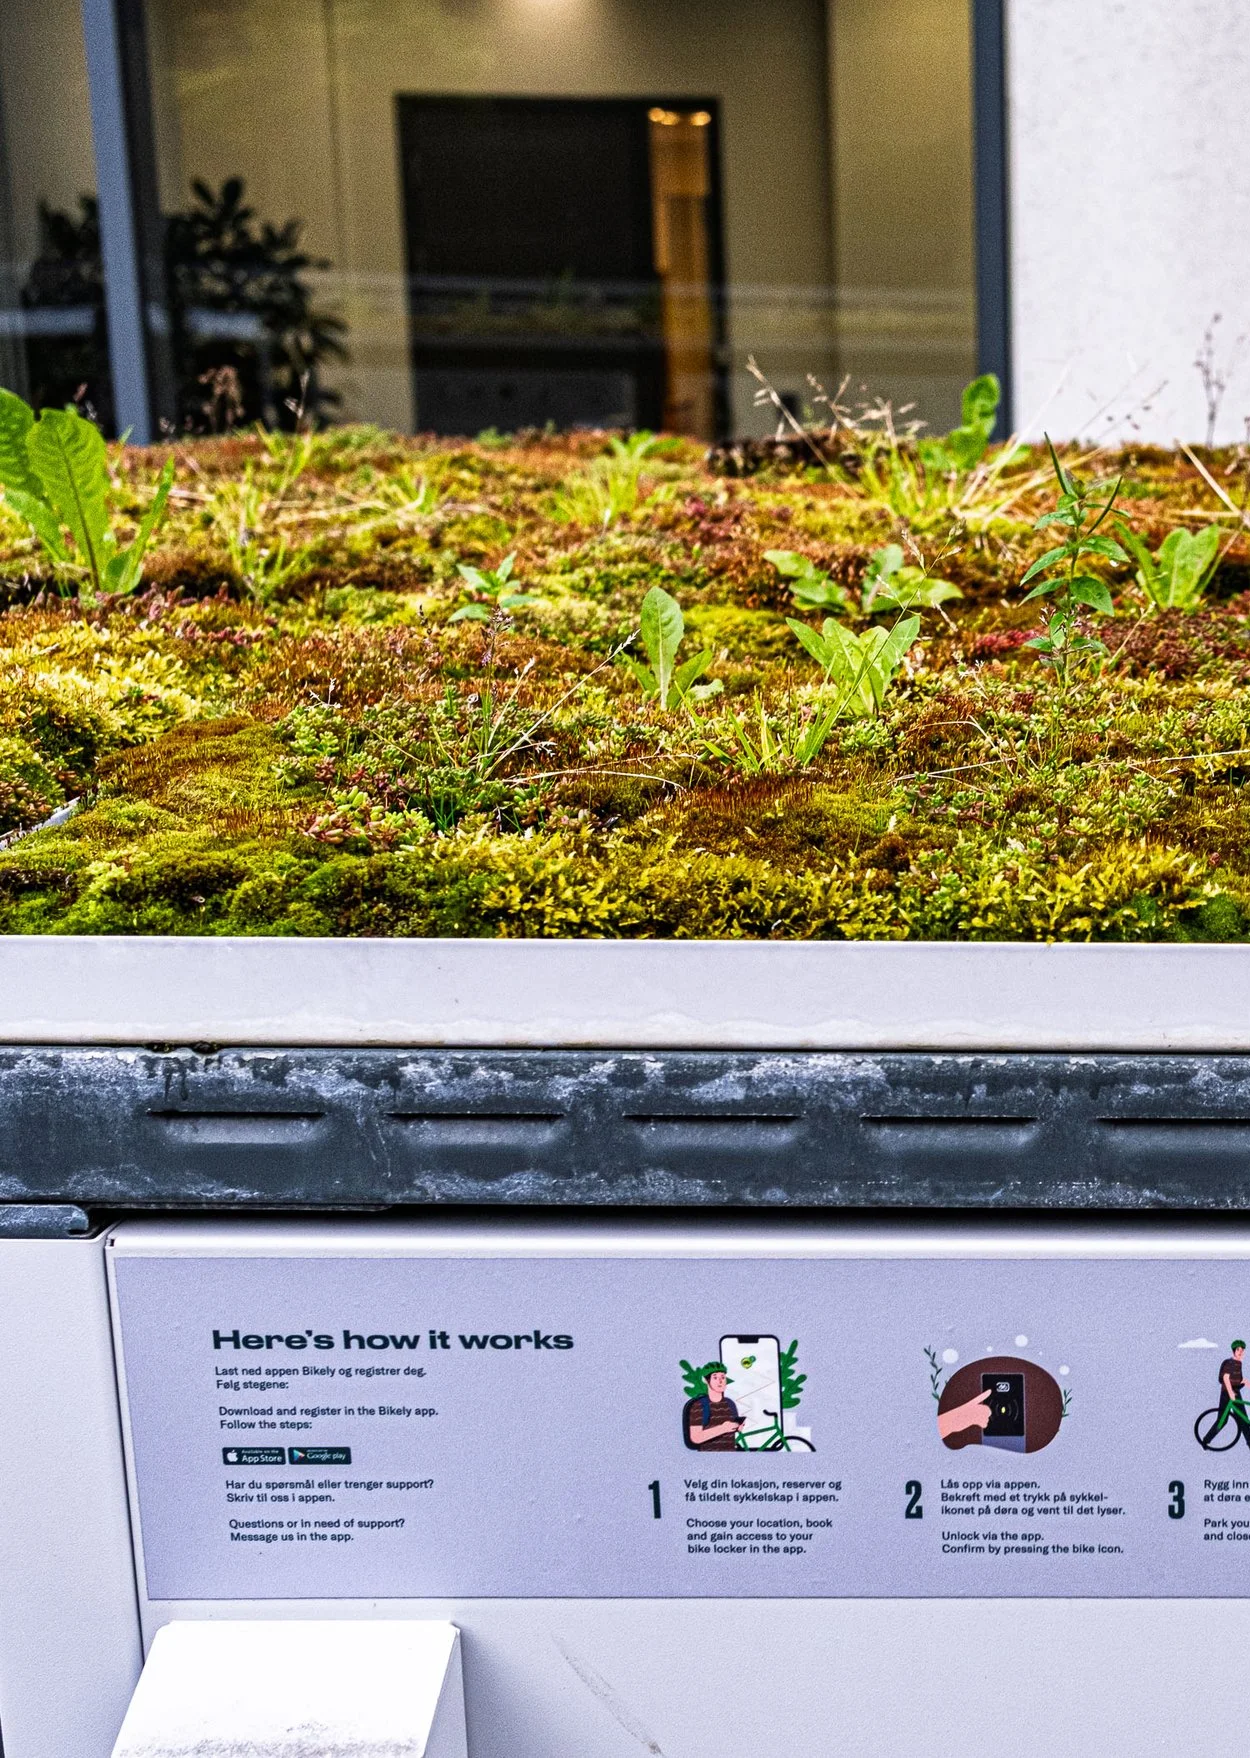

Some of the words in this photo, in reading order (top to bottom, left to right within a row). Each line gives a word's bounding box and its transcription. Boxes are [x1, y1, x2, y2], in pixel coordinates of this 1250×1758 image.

[212, 1330, 335, 1350] Here's
[343, 1330, 420, 1350] how
[429, 1330, 451, 1349] it
[458, 1330, 574, 1350] works
[215, 1366, 239, 1376] Last
[241, 1366, 262, 1376] ned
[265, 1368, 299, 1377] appen
[302, 1366, 336, 1378] Bikely
[338, 1367, 353, 1378] og
[355, 1366, 401, 1378] registrer
[403, 1366, 427, 1378] deg.
[216, 1379, 241, 1391] Følg
[242, 1380, 289, 1391] stegene:
[219, 1406, 273, 1416] Download
[276, 1406, 297, 1416] and
[300, 1406, 342, 1418] register
[344, 1406, 355, 1415] in
[357, 1406, 376, 1416] the
[378, 1406, 412, 1418] Bikely
[415, 1408, 439, 1417] app.
[220, 1419, 256, 1429] Follow
[258, 1420, 277, 1429] the
[279, 1420, 312, 1431] steps:
[241, 1454, 260, 1464] App
[260, 1454, 282, 1462] Store
[306, 1452, 331, 1461] Google
[225, 1480, 245, 1489] Har
[248, 1480, 262, 1489] du
[265, 1479, 315, 1491] spørsmål
[317, 1479, 342, 1489] eller
[344, 1480, 383, 1491] trenger
[386, 1479, 434, 1491] support?
[684, 1479, 708, 1491] Velg
[710, 1479, 728, 1489] din
[731, 1479, 779, 1491] lokasjon,
[782, 1481, 826, 1489] reserver
[828, 1481, 842, 1491] og
[941, 1479, 959, 1489] Lås
[962, 1481, 983, 1491] opp
[985, 1480, 1001, 1489] via
[1004, 1481, 1040, 1491] appen.
[1204, 1479, 1230, 1491] Rygg
[1232, 1480, 1249, 1489] inn
[226, 1493, 254, 1503] Skriv
[256, 1493, 267, 1502] til
[298, 1495, 335, 1504] appen.
[648, 1480, 661, 1519] 1
[685, 1492, 696, 1502] få
[698, 1492, 730, 1502] tildelt
[733, 1492, 793, 1504] sykkelskap
[802, 1494, 839, 1503] appen.
[905, 1480, 923, 1519] 2
[941, 1492, 980, 1502] Bekreft
[983, 1492, 1006, 1502] med
[1009, 1493, 1020, 1502] et
[1023, 1492, 1050, 1504] trykk
[1053, 1492, 1067, 1503] på
[1070, 1492, 1108, 1504] sykkel-
[1168, 1480, 1185, 1520] 3
[1204, 1493, 1214, 1502] at
[1217, 1492, 1241, 1502] døra
[941, 1505, 975, 1515] ikonet
[978, 1505, 991, 1517] på
[994, 1505, 1018, 1515] døra
[1021, 1507, 1034, 1517] og
[1037, 1506, 1060, 1515] vent
[1063, 1505, 1073, 1515] til
[1076, 1505, 1094, 1515] det
[1097, 1505, 1125, 1517] lyser.
[229, 1519, 284, 1530] Questions
[301, 1519, 311, 1528] in
[314, 1519, 341, 1528] need
[343, 1518, 354, 1528] of
[357, 1518, 405, 1530] support?
[686, 1518, 727, 1528] Choose
[729, 1520, 754, 1530] your
[756, 1518, 803, 1529] location,
[806, 1518, 833, 1528] book
[1204, 1518, 1228, 1528] Park
[230, 1532, 278, 1544] Message
[296, 1532, 307, 1541] in
[309, 1532, 328, 1541] the
[330, 1534, 354, 1543] app.
[687, 1531, 707, 1541] and
[710, 1531, 733, 1543] gain
[736, 1533, 773, 1541] access
[776, 1532, 787, 1541] to
[789, 1533, 813, 1543] your
[942, 1531, 980, 1541] Unlock
[982, 1531, 998, 1540] via
[1000, 1531, 1018, 1541] the
[1021, 1533, 1044, 1542] app.
[1203, 1531, 1224, 1541] and
[688, 1544, 711, 1554] bike
[714, 1544, 747, 1553] locker
[750, 1544, 760, 1553] in
[762, 1544, 780, 1554] the
[783, 1546, 806, 1555] app.
[942, 1544, 985, 1553] Confirm
[988, 1544, 1001, 1555] by
[1004, 1544, 1049, 1555] pressing
[1051, 1544, 1069, 1553] the
[1072, 1544, 1095, 1553] bike
[1098, 1544, 1124, 1553] icon.
